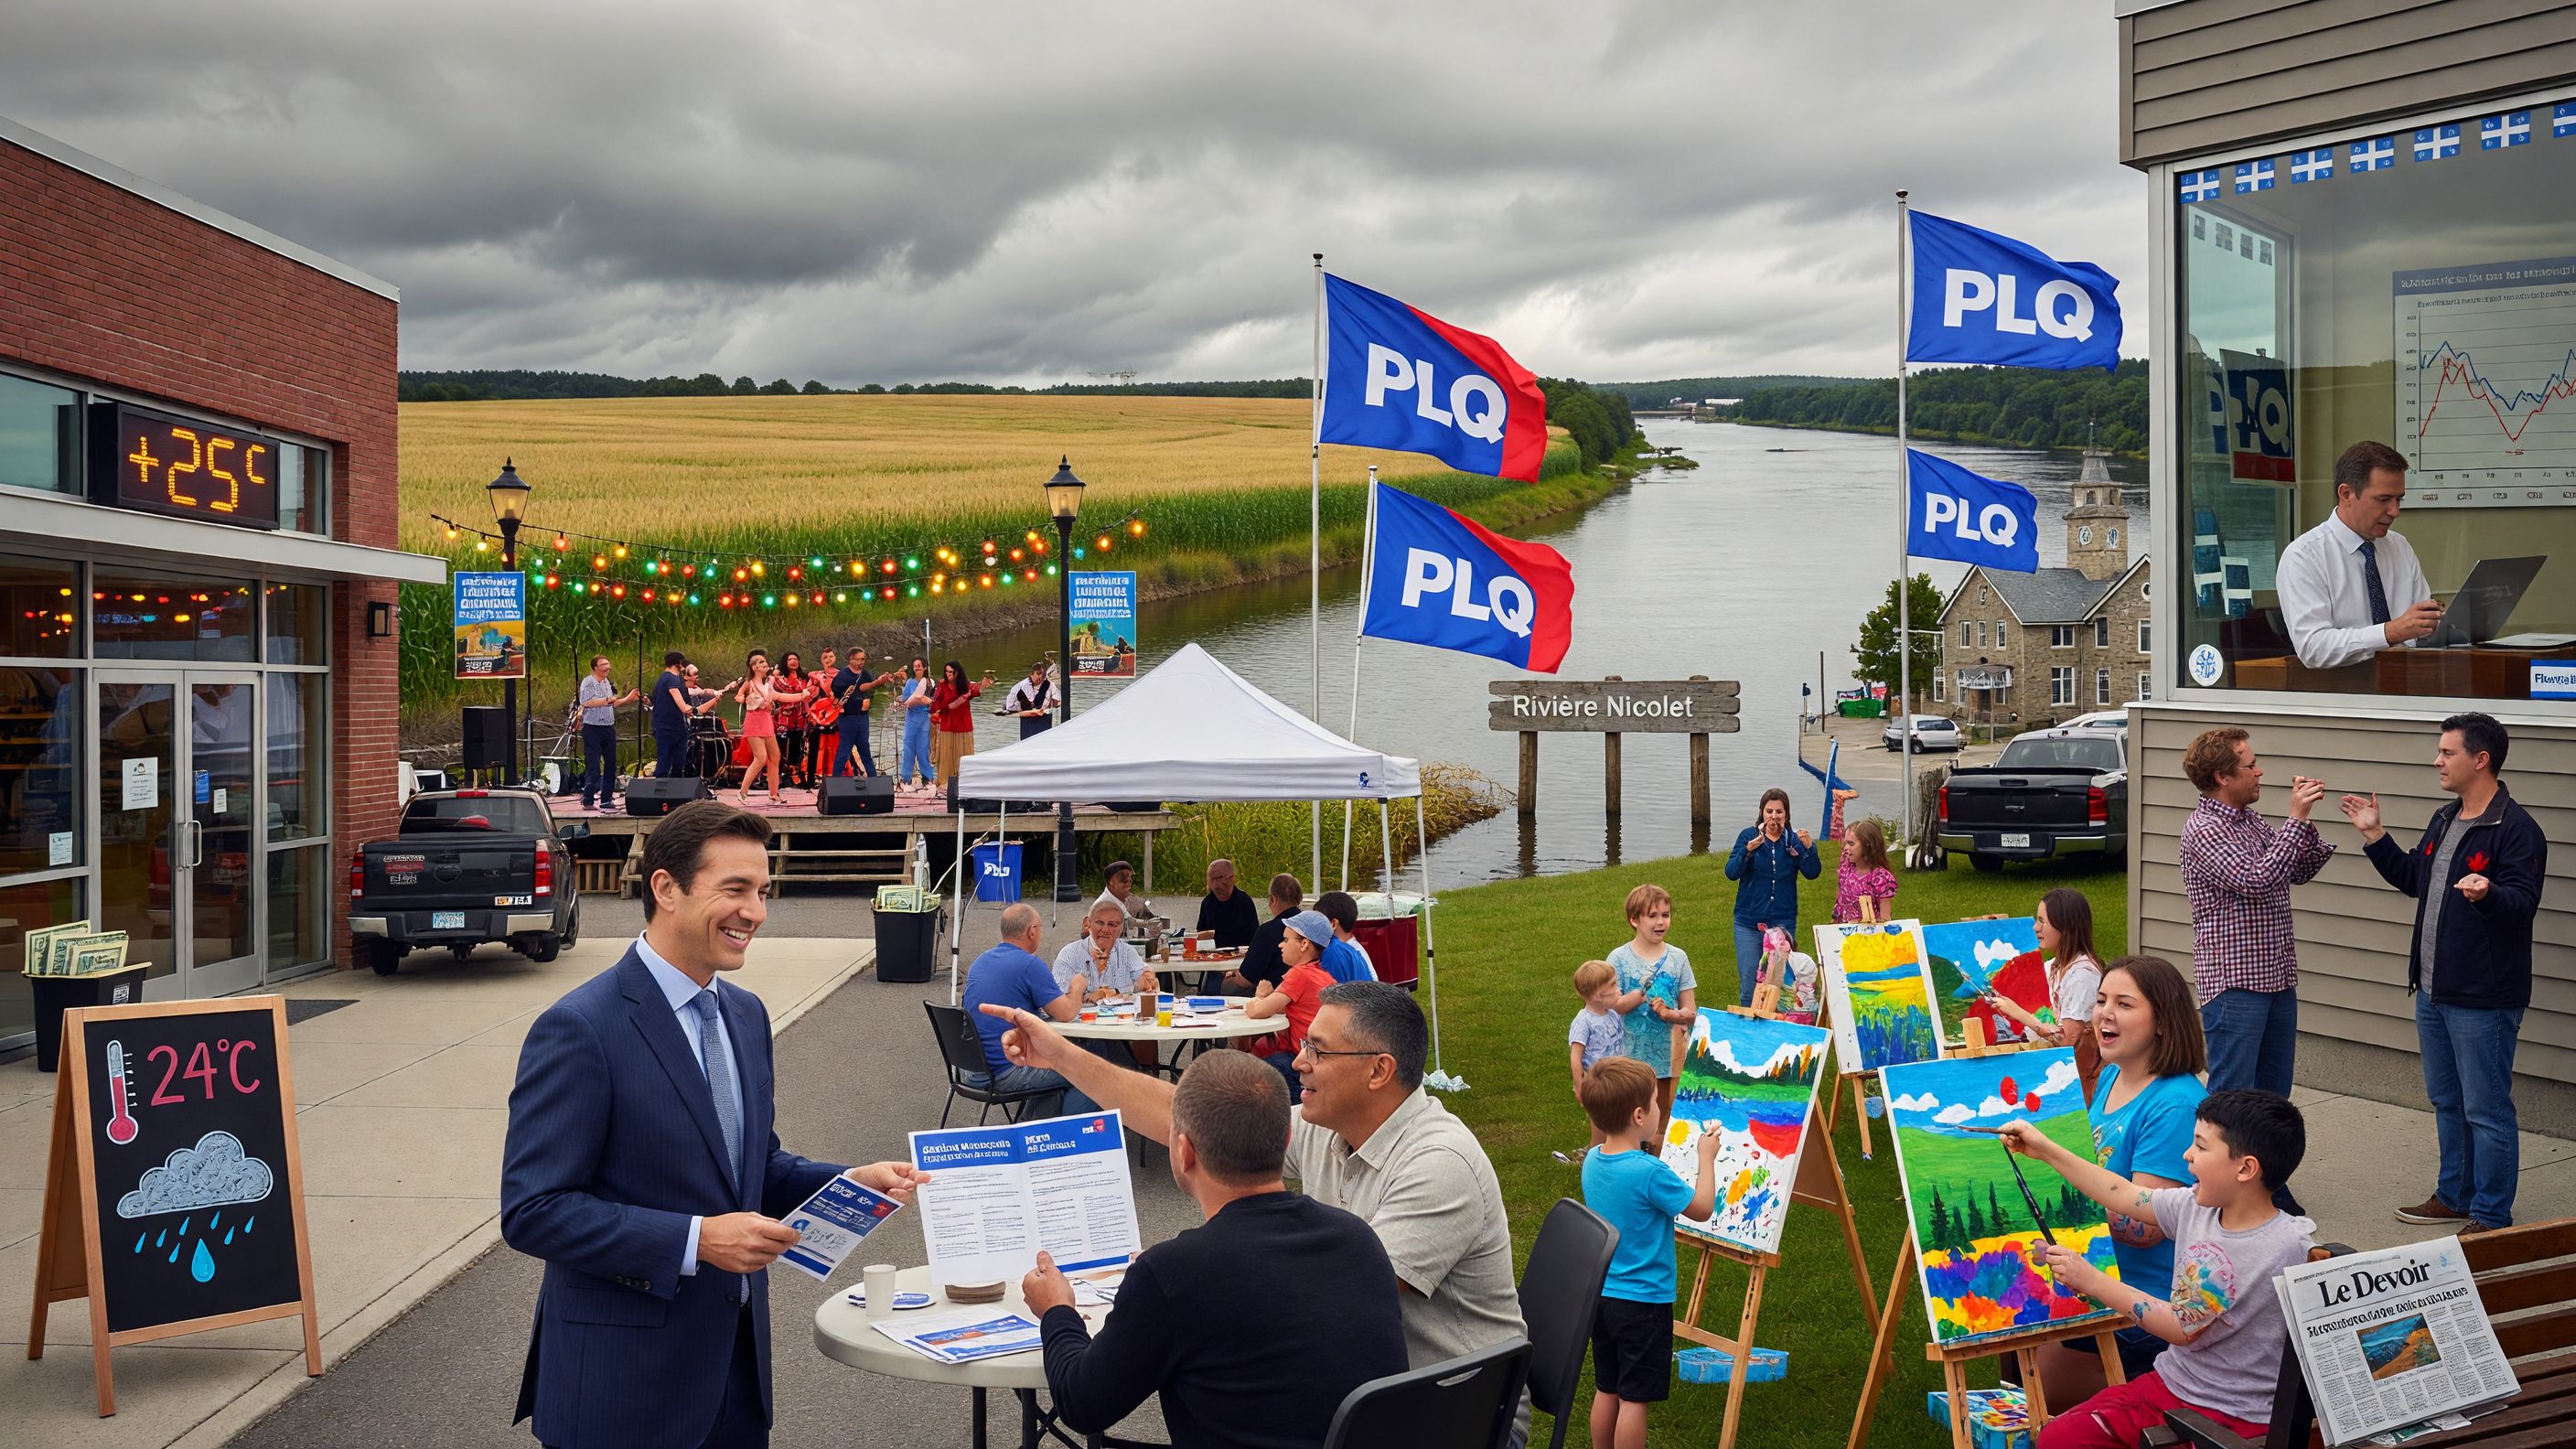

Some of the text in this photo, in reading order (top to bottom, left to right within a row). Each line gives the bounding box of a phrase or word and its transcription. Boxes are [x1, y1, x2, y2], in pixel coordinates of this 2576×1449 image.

[1944, 268, 2095, 343] PLQ
[1365, 342, 1508, 445] PLQ
[1925, 492, 2019, 548] PLQ
[1401, 547, 1534, 639] PLQ
[1513, 694, 1693, 717] Rivière Nicolet
[147, 1039, 260, 1106] 24°C
[2317, 1259, 2431, 1308] Le Devoir
